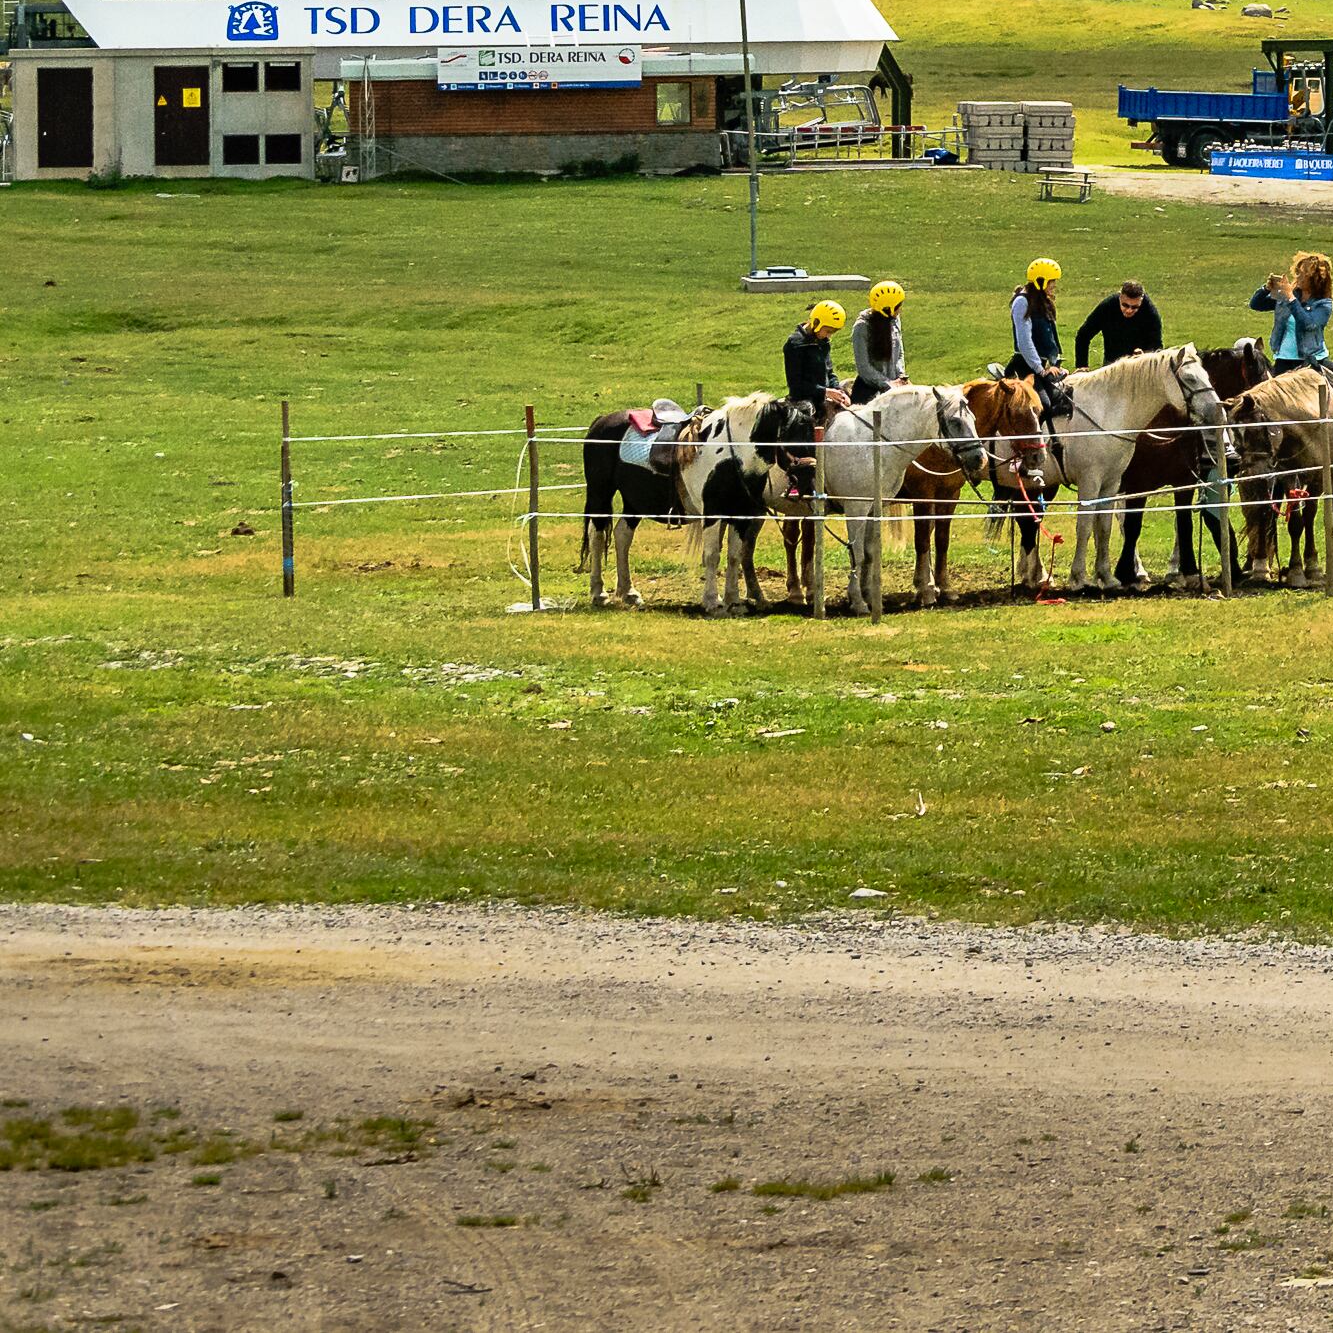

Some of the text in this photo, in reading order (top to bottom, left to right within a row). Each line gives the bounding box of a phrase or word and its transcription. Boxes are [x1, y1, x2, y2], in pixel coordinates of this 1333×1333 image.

[304, 3, 671, 35] TSD DERA REINA
[497, 51, 607, 64] TSD. DERA REINA
